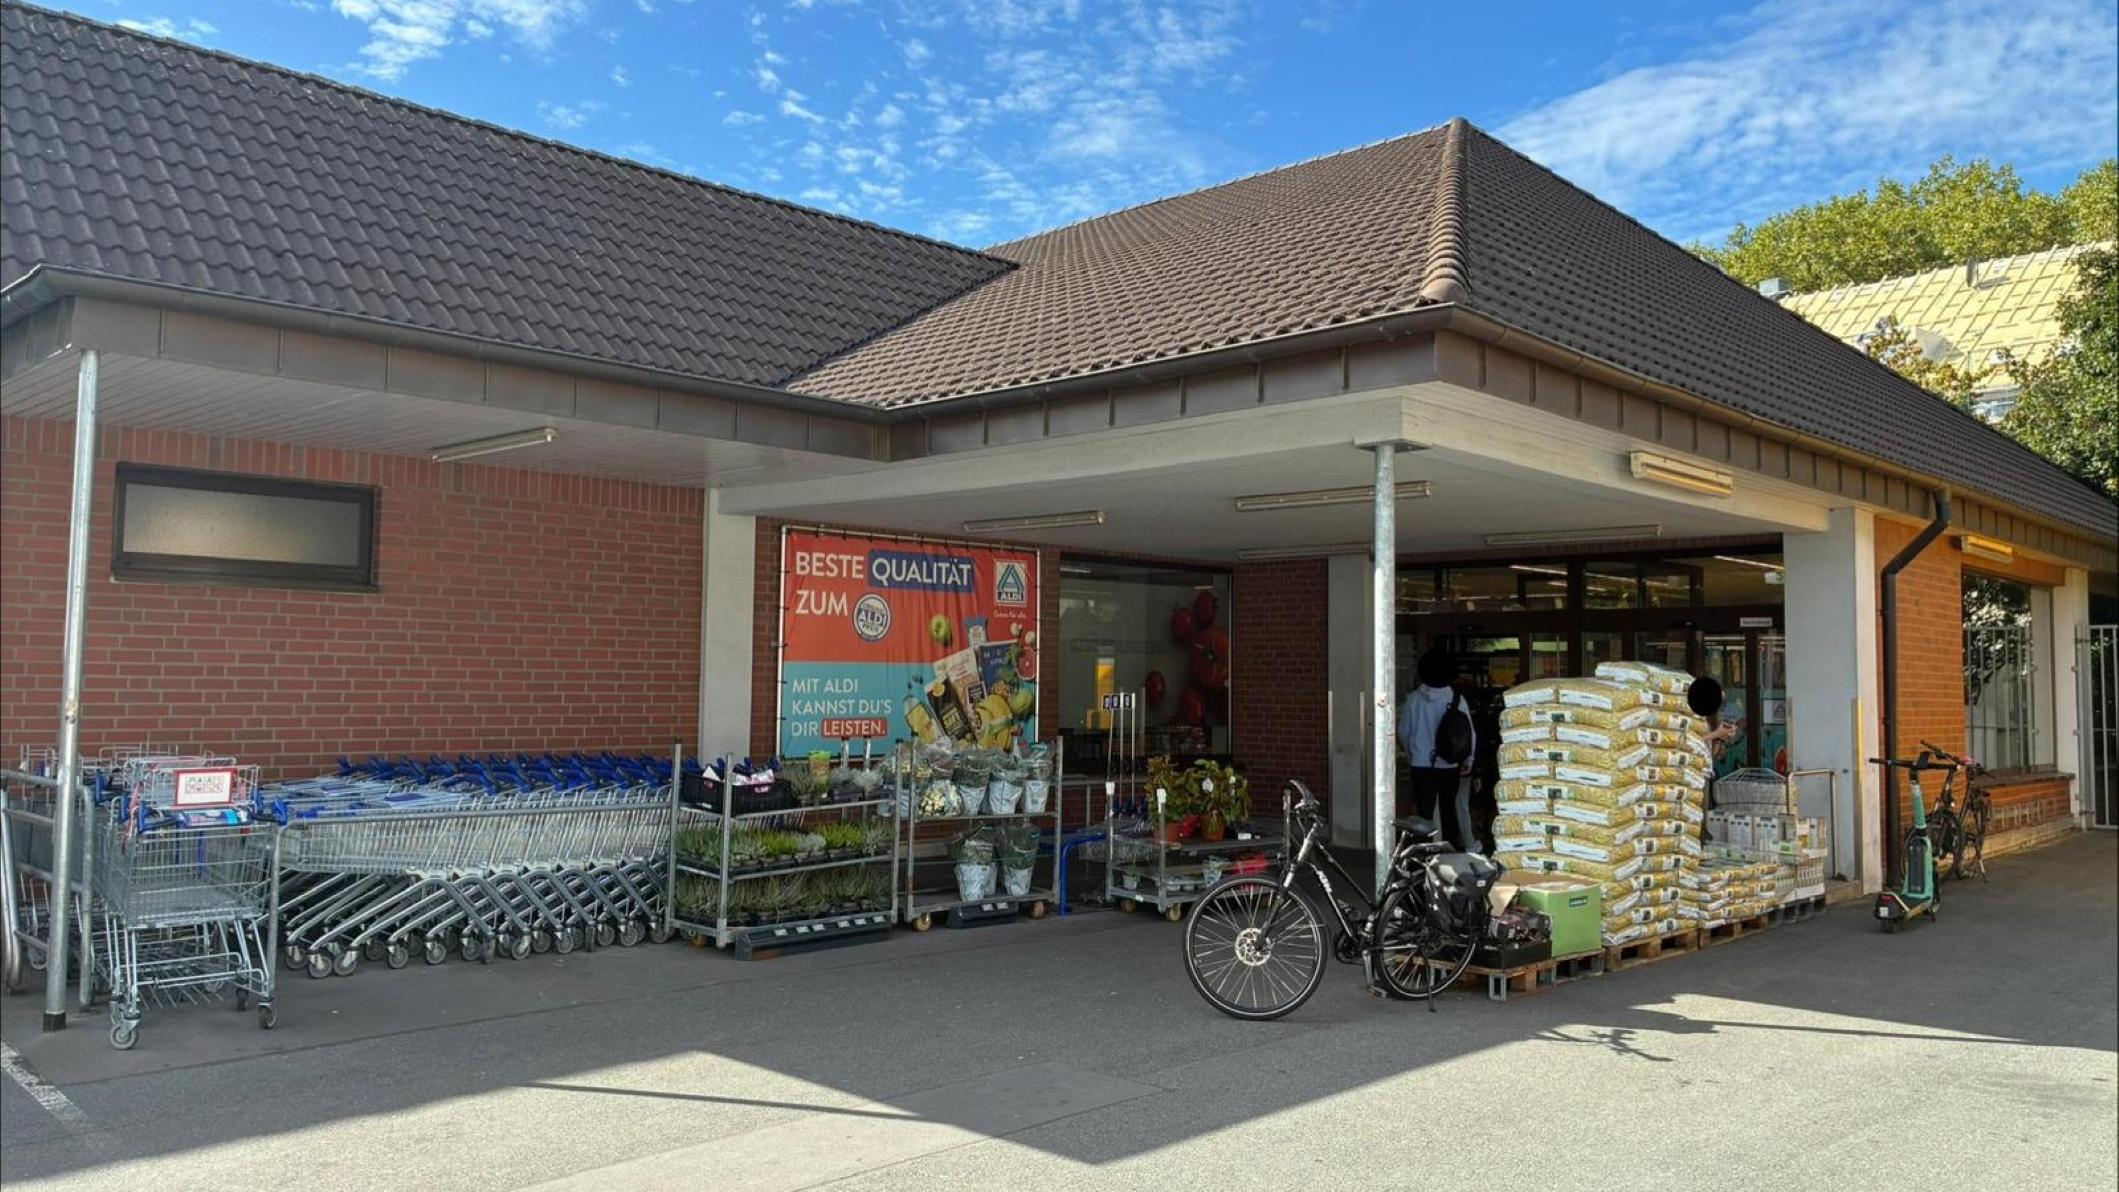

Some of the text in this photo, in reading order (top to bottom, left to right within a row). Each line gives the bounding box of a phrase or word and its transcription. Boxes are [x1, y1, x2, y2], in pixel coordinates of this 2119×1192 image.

[795, 551, 971, 587] BESTE QUALITÄT
[795, 590, 849, 617] ZUM
[999, 591, 1022, 601] ALDI
[858, 609, 888, 626] ALDI
[792, 678, 859, 694] MIT ALDI
[792, 699, 892, 716] KANNST DU'S
[791, 719, 886, 737] DIR LEISTEN.
